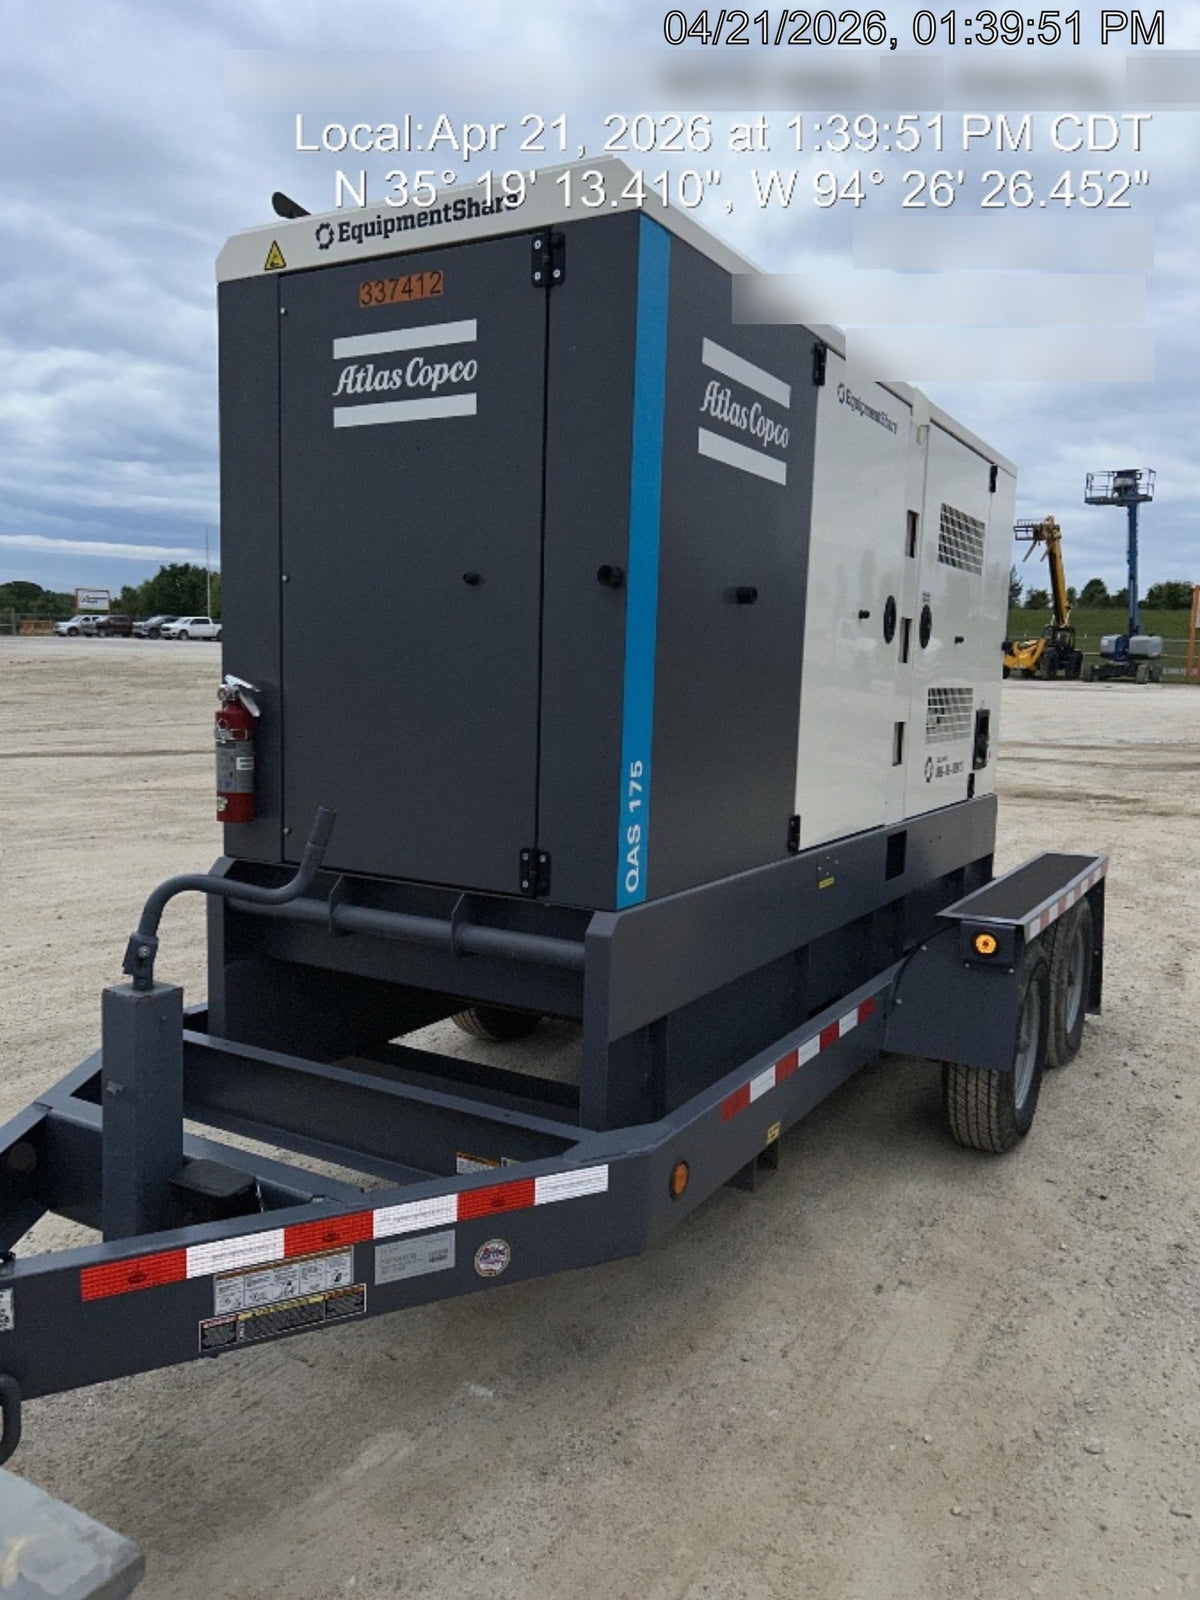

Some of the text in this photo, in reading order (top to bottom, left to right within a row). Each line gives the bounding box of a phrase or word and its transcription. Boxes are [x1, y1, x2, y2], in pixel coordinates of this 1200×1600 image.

[360, 271, 443, 305] 337412
[332, 356, 478, 397] Atlas Copco
[700, 379, 790, 449] Atlas Copco
[625, 760, 643, 893] QAS 175
